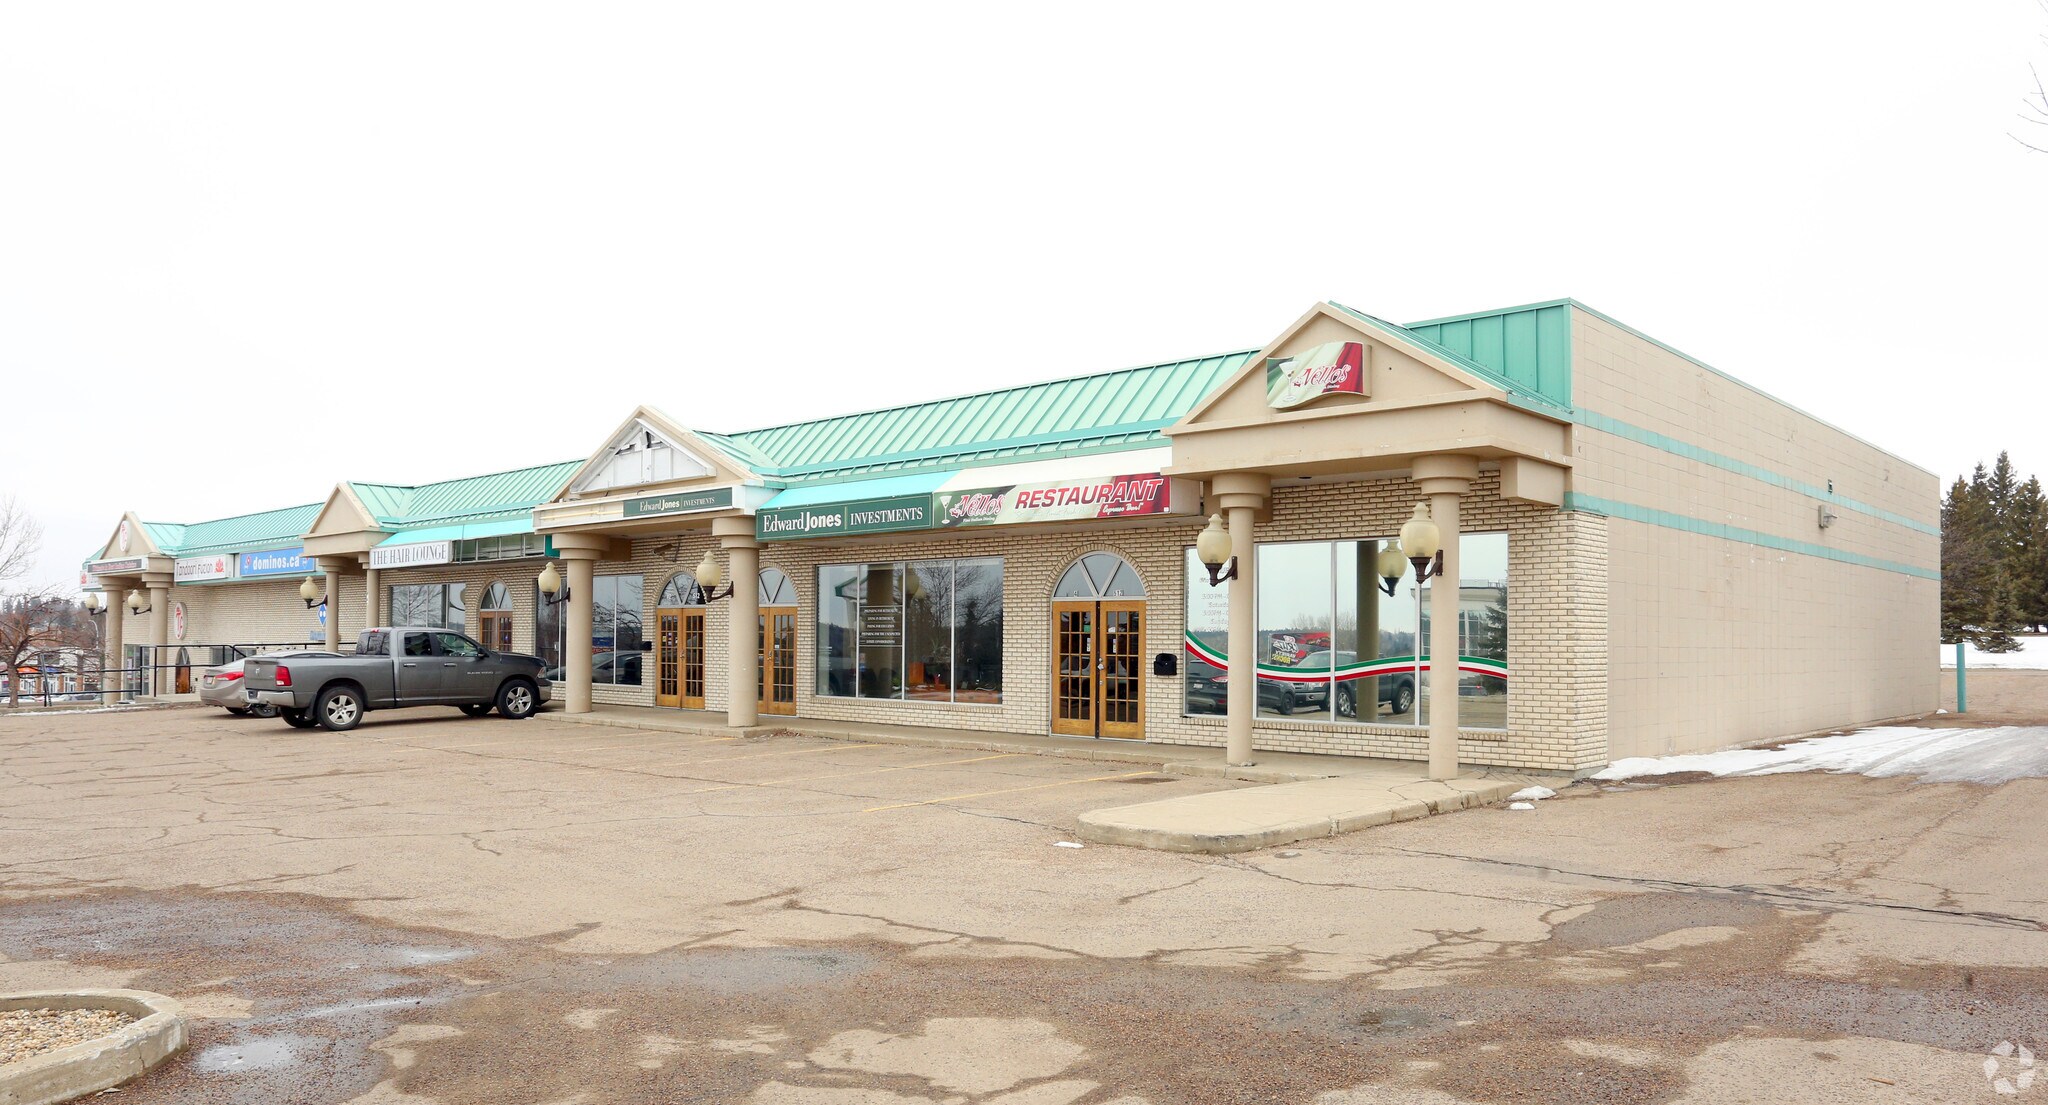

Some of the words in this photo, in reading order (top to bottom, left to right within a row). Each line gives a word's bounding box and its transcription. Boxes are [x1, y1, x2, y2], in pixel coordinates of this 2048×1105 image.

[661, 499, 680, 511] Jones
[1015, 480, 1163, 510] RESTAURANT
[763, 513, 804, 533] Edward
[804, 512, 842, 532] Jones
[850, 507, 923, 526] INVESTMENTS
[253, 555, 300, 570] dominos.ca
[373, 550, 388, 565] THE
[389, 548, 410, 564] HAIR
[412, 544, 447, 562] LOUNGE
